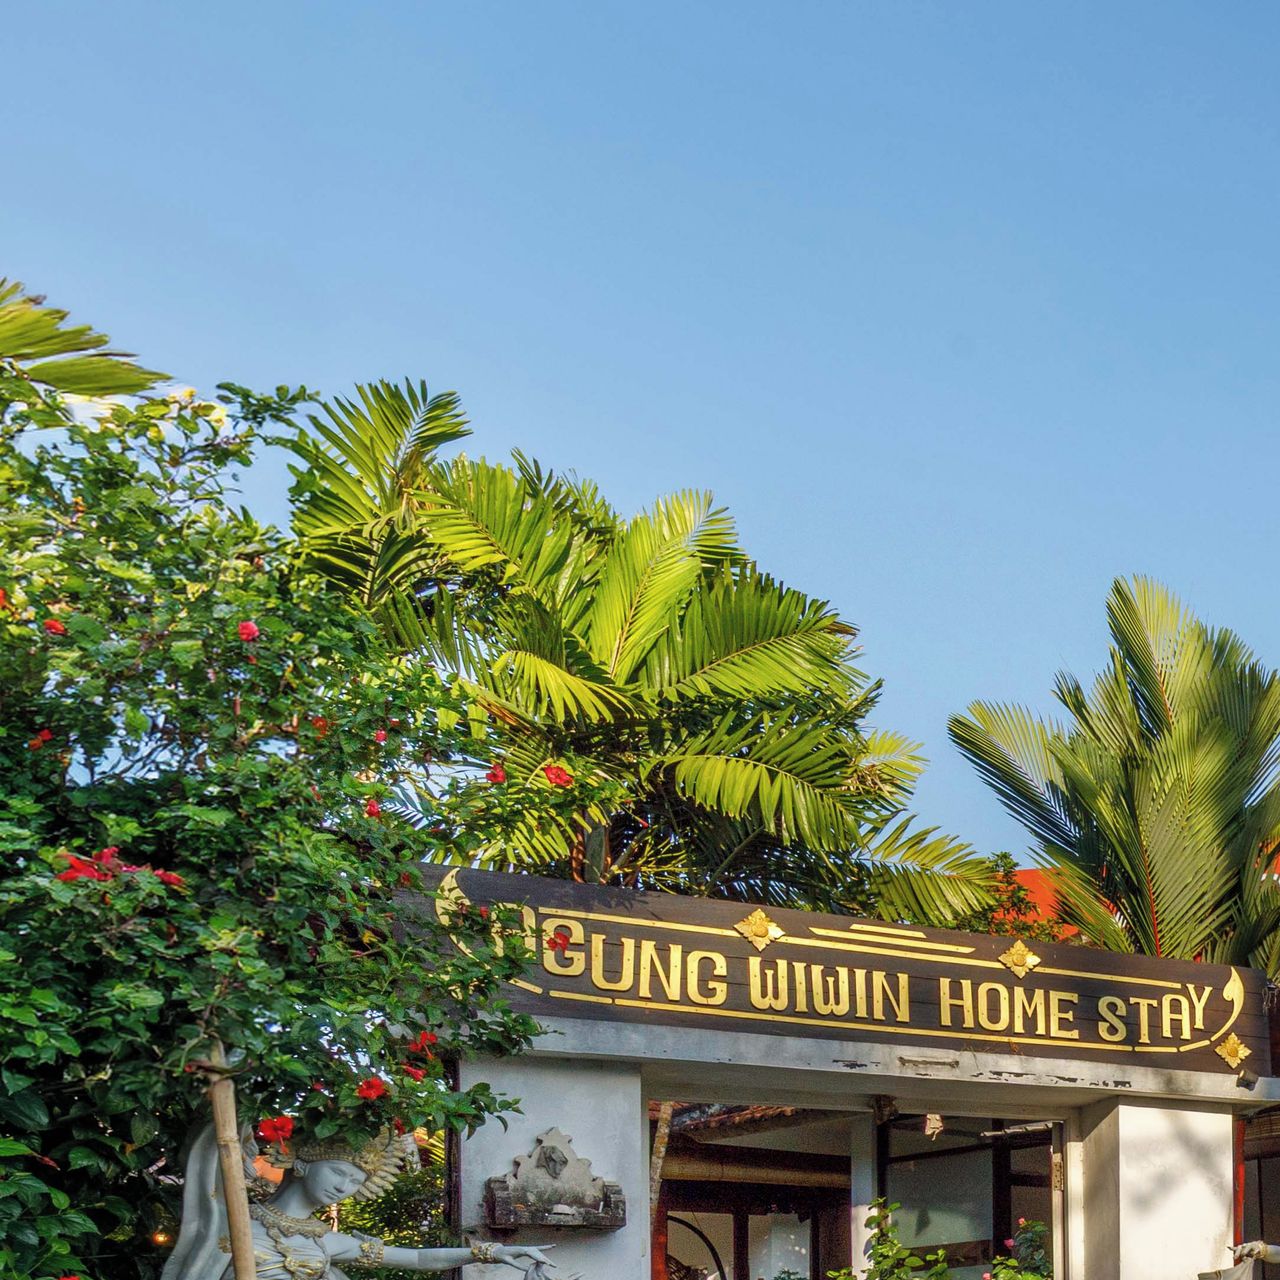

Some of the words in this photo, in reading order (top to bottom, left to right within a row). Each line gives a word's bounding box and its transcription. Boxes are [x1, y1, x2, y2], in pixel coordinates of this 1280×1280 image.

[748, 955, 909, 1023] WIWIN
[939, 976, 1080, 1040] HOME
[1097, 983, 1214, 1044] STAY
